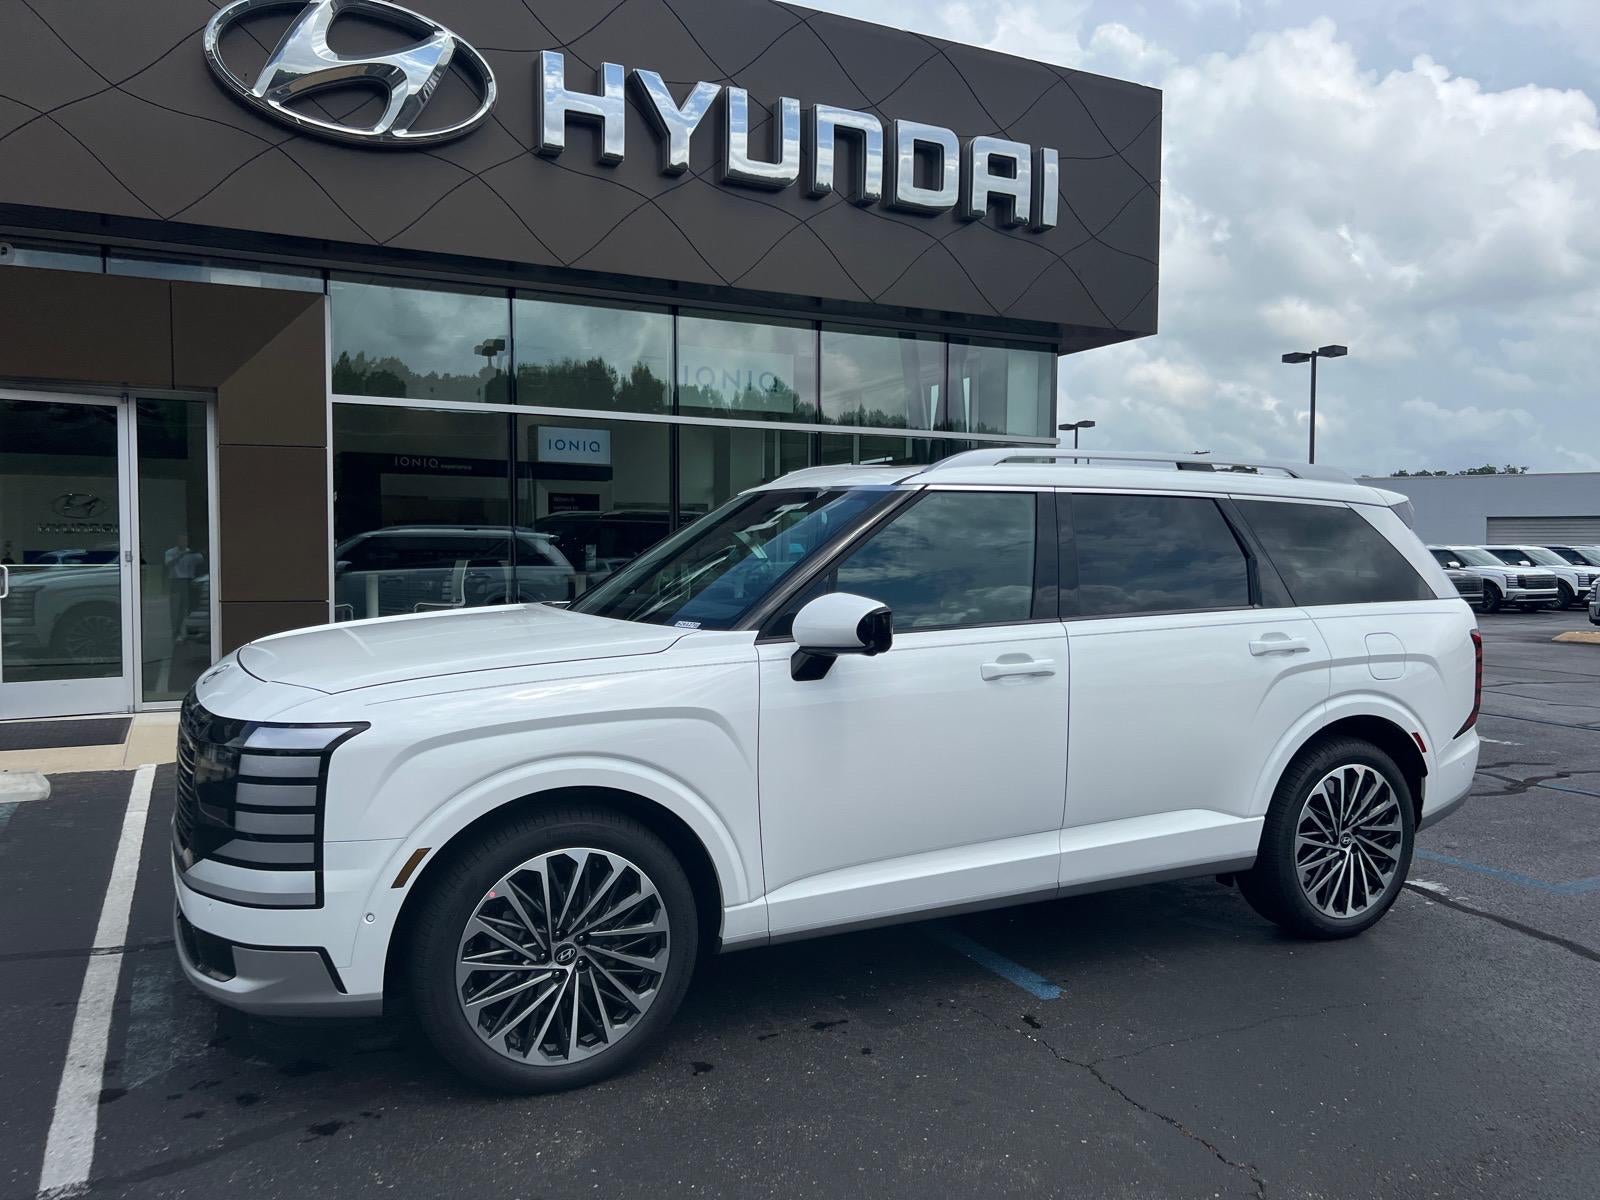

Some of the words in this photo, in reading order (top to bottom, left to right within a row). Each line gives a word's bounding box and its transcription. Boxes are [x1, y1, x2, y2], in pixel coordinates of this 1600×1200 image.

[538, 50, 1059, 233] HYUNDAI
[683, 365, 779, 393] IONIQ
[548, 438, 601, 453] IONIQ
[394, 455, 439, 469] IONIQ
